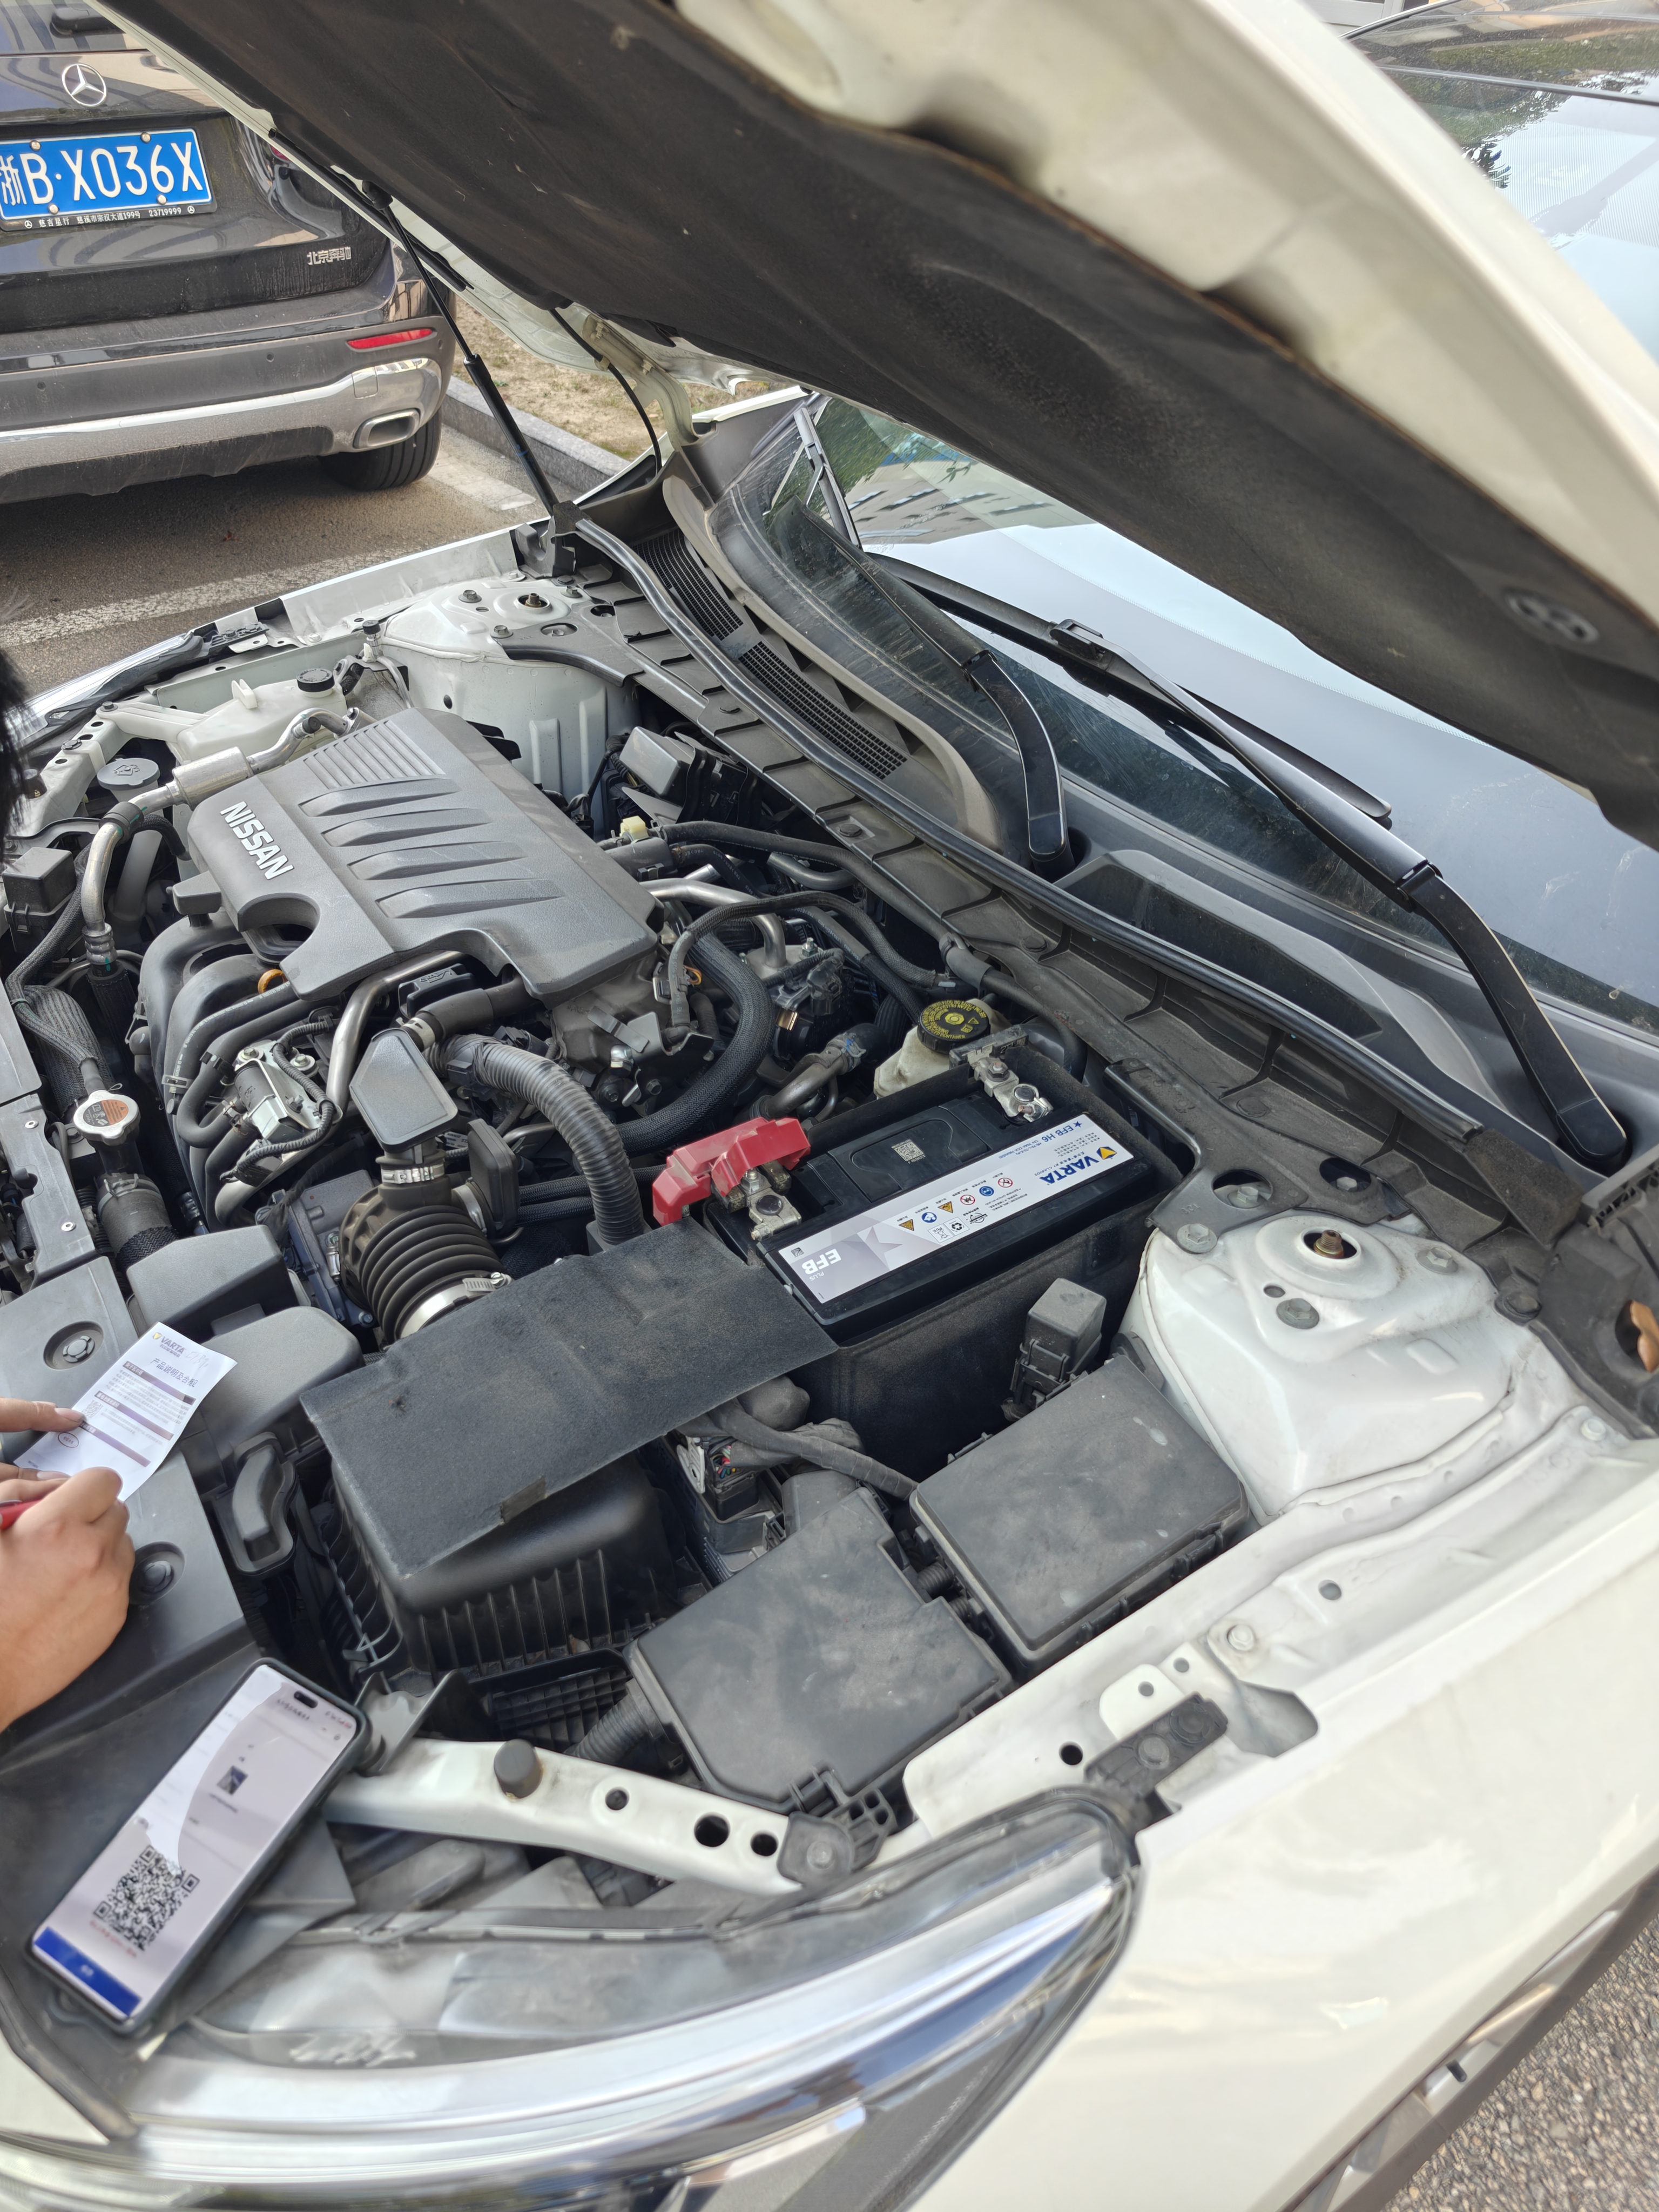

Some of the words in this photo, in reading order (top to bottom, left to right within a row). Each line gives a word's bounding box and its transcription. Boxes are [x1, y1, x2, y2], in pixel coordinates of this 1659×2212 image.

[39, 217, 70, 228] 慈吉星行
[77, 210, 140, 225] 慈溪市宗汉大道199号
[149, 207, 181, 217] 23719999
[306, 246, 352, 265] 北京奔驰
[220, 801, 294, 880] NISSAN
[1040, 1132, 1056, 1142] H6
[1054, 1124, 1074, 1136] EFB
[1038, 1153, 1100, 1186] VARTA
[801, 1248, 842, 1274] EFB
[807, 1270, 825, 1281] PLUS
[161, 1336, 186, 1355] VARTA
